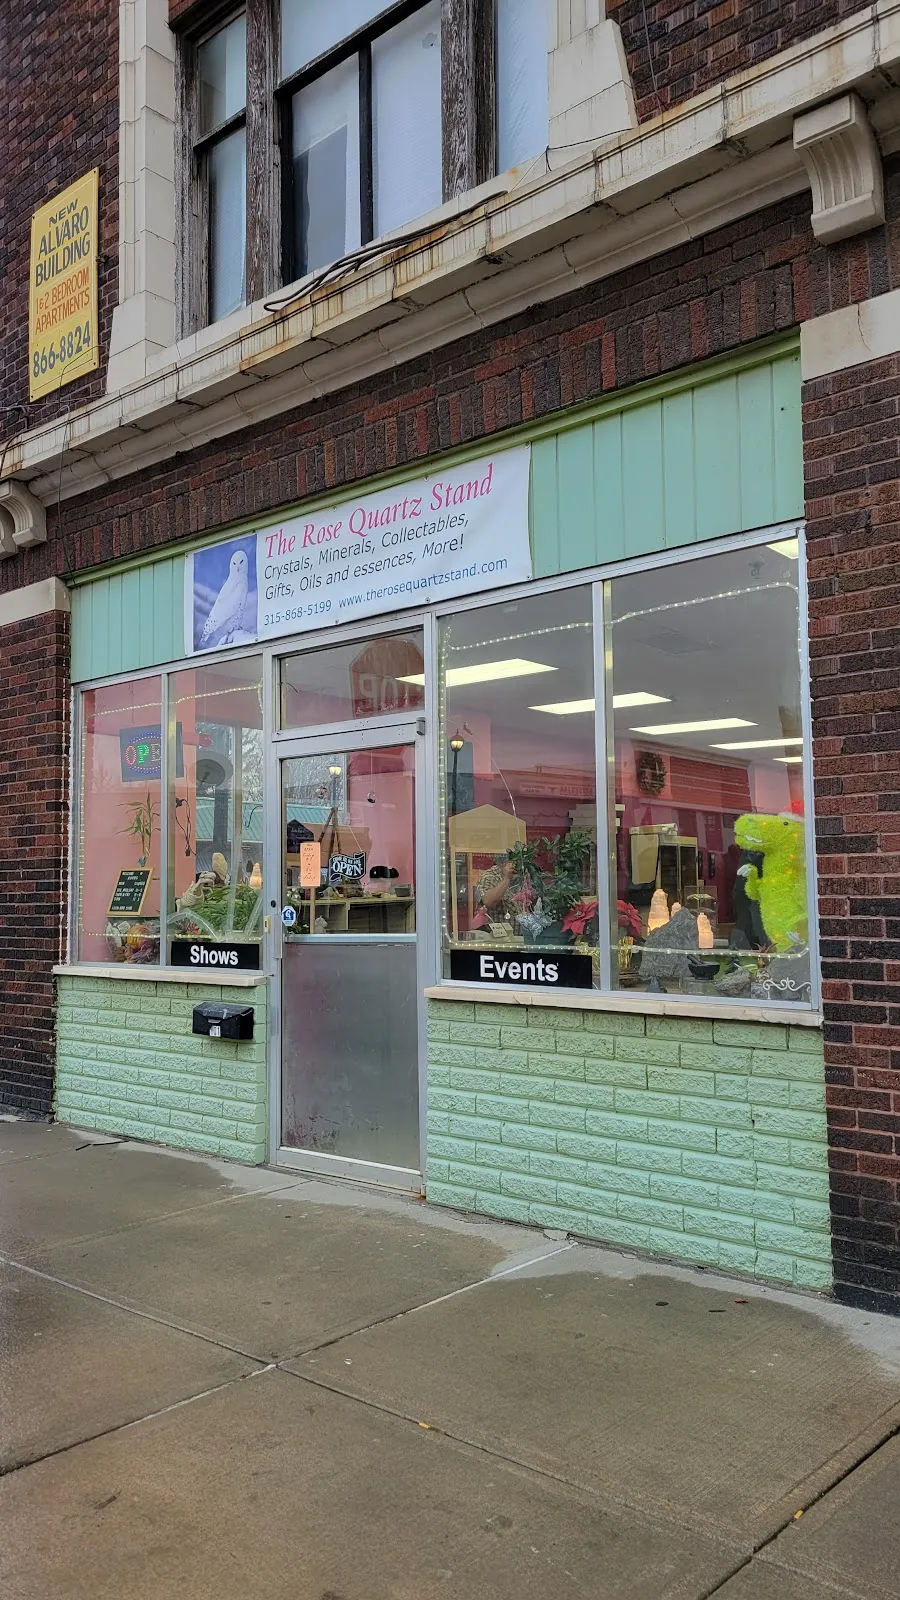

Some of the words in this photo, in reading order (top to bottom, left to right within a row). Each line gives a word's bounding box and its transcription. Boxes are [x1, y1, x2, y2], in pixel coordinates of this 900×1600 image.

[38, 205, 89, 260] ALVARO
[48, 199, 78, 226] NEW
[35, 232, 91, 287] BUILDING
[51, 266, 89, 306] BEDROOM
[35, 288, 90, 335] APARTMENTS
[33, 321, 91, 378] 866-8824
[265, 532, 296, 559] The
[301, 520, 343, 548] Rose
[348, 497, 422, 537] Quartz
[430, 463, 494, 512] Stand
[264, 554, 314, 581] Crystals,
[318, 536, 375, 566] Minerals,
[381, 511, 469, 549] Collectables,
[264, 580, 295, 601] Gifts,
[299, 571, 322, 592] Oils
[326, 566, 349, 588] and
[353, 552, 416, 577] essences,
[422, 534, 464, 560] More!
[264, 599, 332, 626] 315-868-5199
[338, 557, 508, 609] www.therosequartzstand.com
[332, 861, 362, 876] OPEN
[189, 944, 239, 966] Shows
[480, 955, 559, 982] Events
